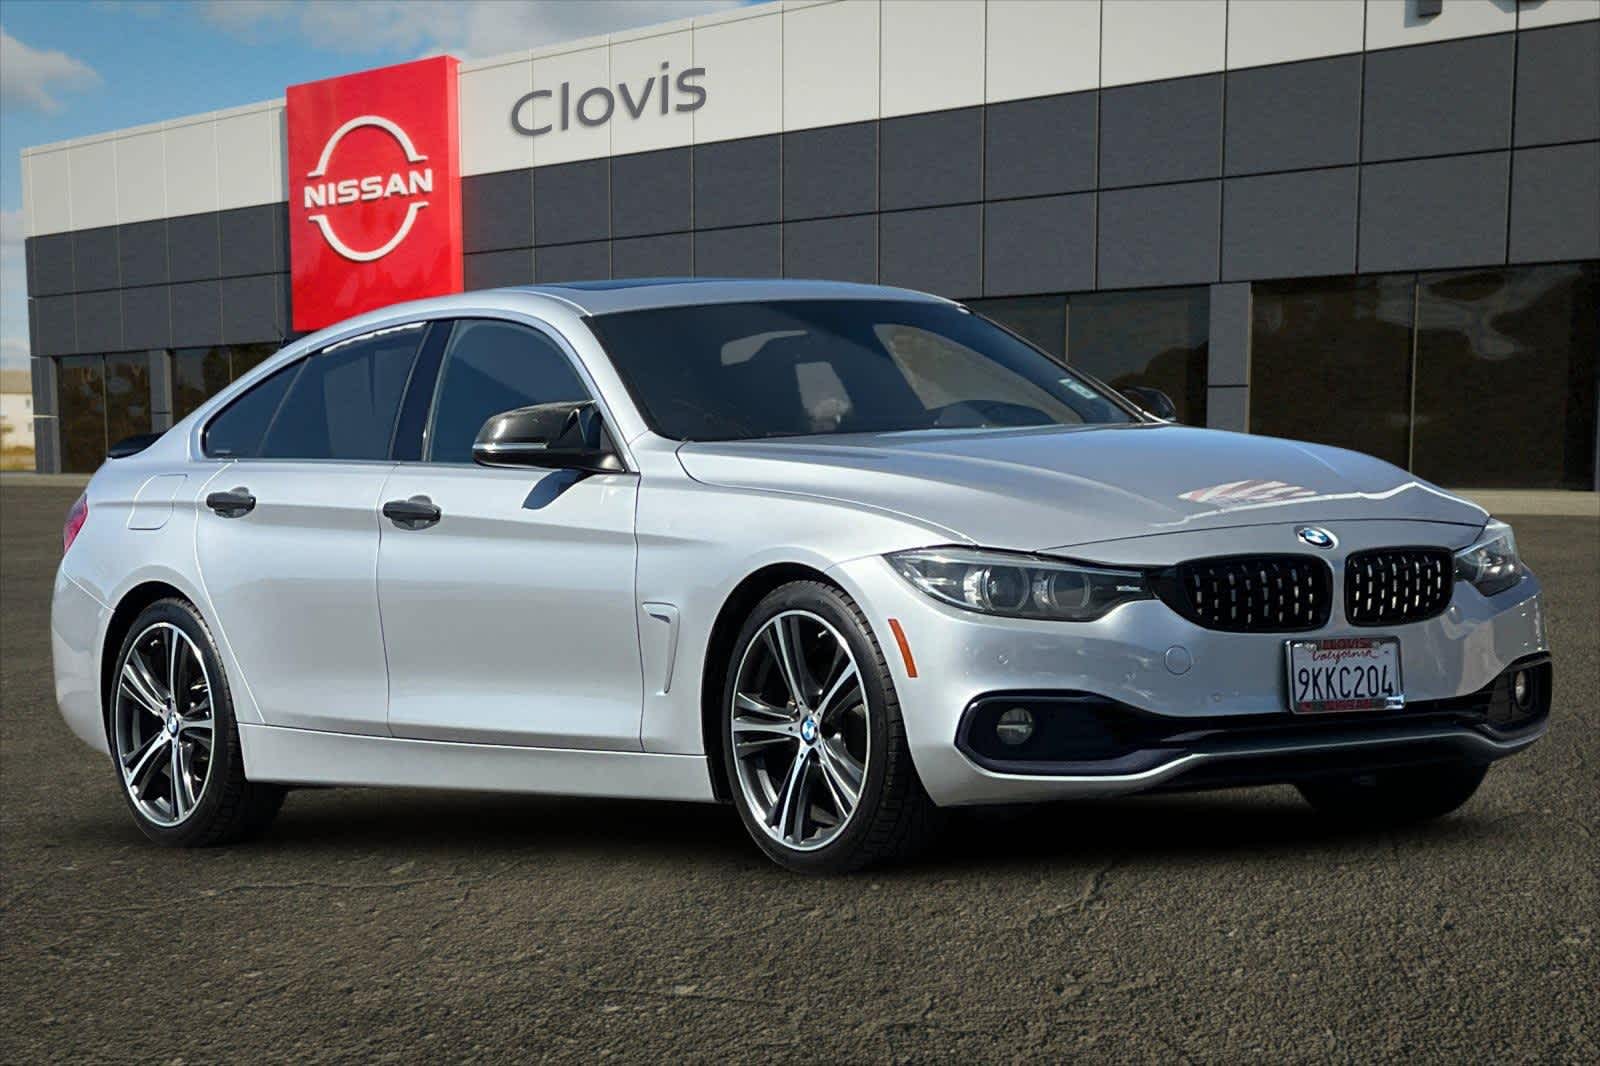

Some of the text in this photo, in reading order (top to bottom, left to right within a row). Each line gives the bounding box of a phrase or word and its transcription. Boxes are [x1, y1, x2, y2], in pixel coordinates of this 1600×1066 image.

[511, 61, 707, 136] Clovis
[304, 168, 433, 208] NISSAN
[1298, 664, 1394, 700] 9KKC204
